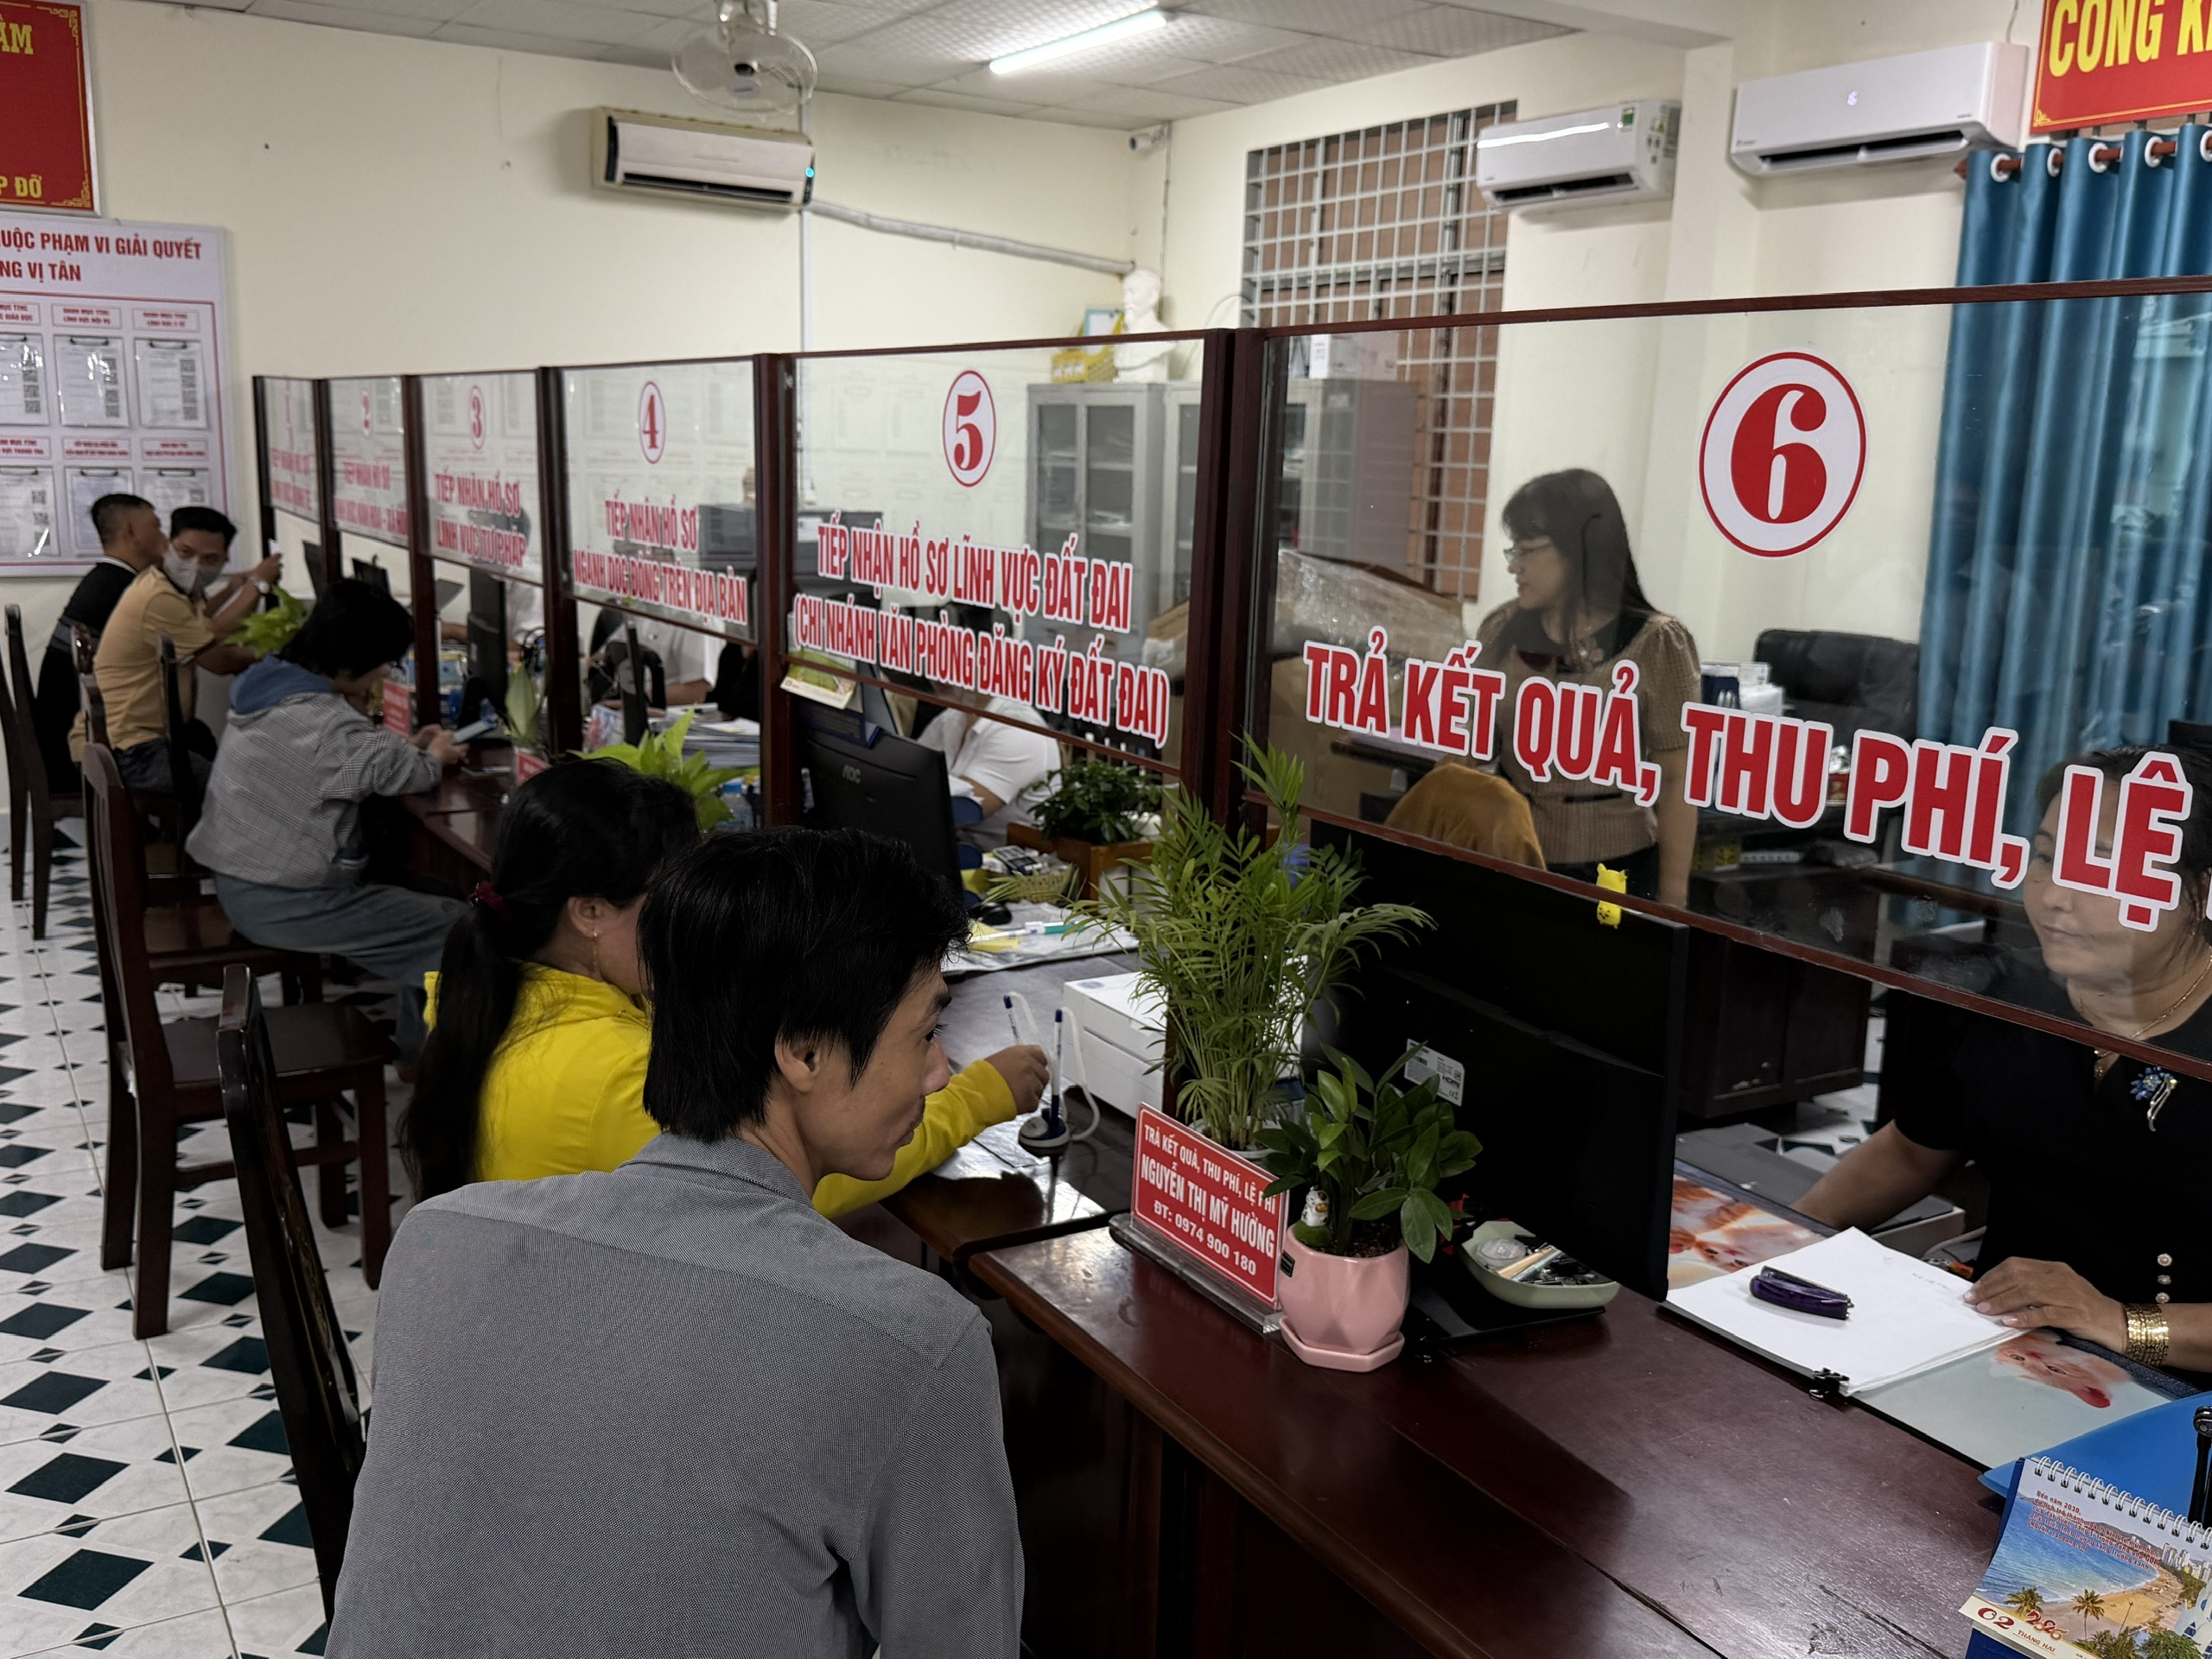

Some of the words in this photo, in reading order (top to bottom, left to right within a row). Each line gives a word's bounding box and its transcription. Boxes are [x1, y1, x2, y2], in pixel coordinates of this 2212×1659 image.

[14, 174, 42, 199] ĐỠ
[27, 262, 44, 283] VỊ
[48, 260, 81, 282] TÂN
[40, 232, 90, 256] PHẠM
[94, 236, 110, 254] VI
[115, 232, 148, 256] GIẢI
[153, 237, 201, 260] QUYẾT
[472, 396, 484, 439] 3
[642, 393, 659, 450] 4
[953, 390, 984, 472] 5
[1729, 382, 1827, 524] 6
[604, 489, 627, 540] TIẾP
[628, 496, 661, 555] NHẬN
[661, 493, 678, 549] HỒ
[681, 506, 698, 552] SƠ
[573, 543, 606, 589] NGÀNH
[661, 556, 693, 610] TRÊN
[694, 569, 716, 624] ĐỊA
[718, 565, 747, 624] BÀN
[817, 512, 849, 579] TIẾP
[851, 521, 895, 598] NHẬN
[899, 519, 920, 591] HỒ
[925, 536, 950, 597] SƠ
[953, 533, 995, 607] LĨNH
[1001, 547, 1039, 624] VỰC
[1045, 536, 1087, 622] ĐẤT
[1090, 563, 1132, 632] ĐAI
[794, 594, 823, 650] (CHI
[825, 595, 877, 663] NHÁNH
[879, 604, 912, 672] VĂN
[914, 611, 975, 689] PHÒNG
[977, 626, 1032, 703] ĐĂNG
[1036, 638, 1065, 713] KÝ
[1069, 637, 1114, 725] ĐẤT
[1117, 665, 1168, 746] ĐAI)
[1304, 629, 1389, 734] TRẢ
[1403, 644, 1504, 759] KẾT
[1516, 664, 1658, 804] QUẢ,
[1684, 707, 1829, 823] THU
[1847, 734, 2025, 884] PHÍ,
[2058, 760, 2187, 926] LỆ
[1143, 1124, 1160, 1148] TRẢ
[1161, 1134, 1179, 1158] KẾT
[1179, 1147, 1201, 1173] QUẢ,
[1202, 1157, 1222, 1183] THU
[1223, 1170, 1243, 1198] PHÍ,
[1244, 1181, 1256, 1206] LỆ
[1141, 1153, 1185, 1203] NGUYỄN
[1186, 1180, 1207, 1223] THỊ
[1209, 1194, 1230, 1229] MỸ
[1230, 1207, 1275, 1259] HƯỜNG
[1154, 1199, 1173, 1223] ĐT:
[1175, 1213, 1205, 1243] 0974
[1206, 1233, 1230, 1259] 900
[1233, 1250, 1257, 1276] 180
[1977, 1607, 2015, 1630] 02
[2017, 1629, 2041, 1646] THÁNG
[2041, 1643, 2056, 1653] HAI
